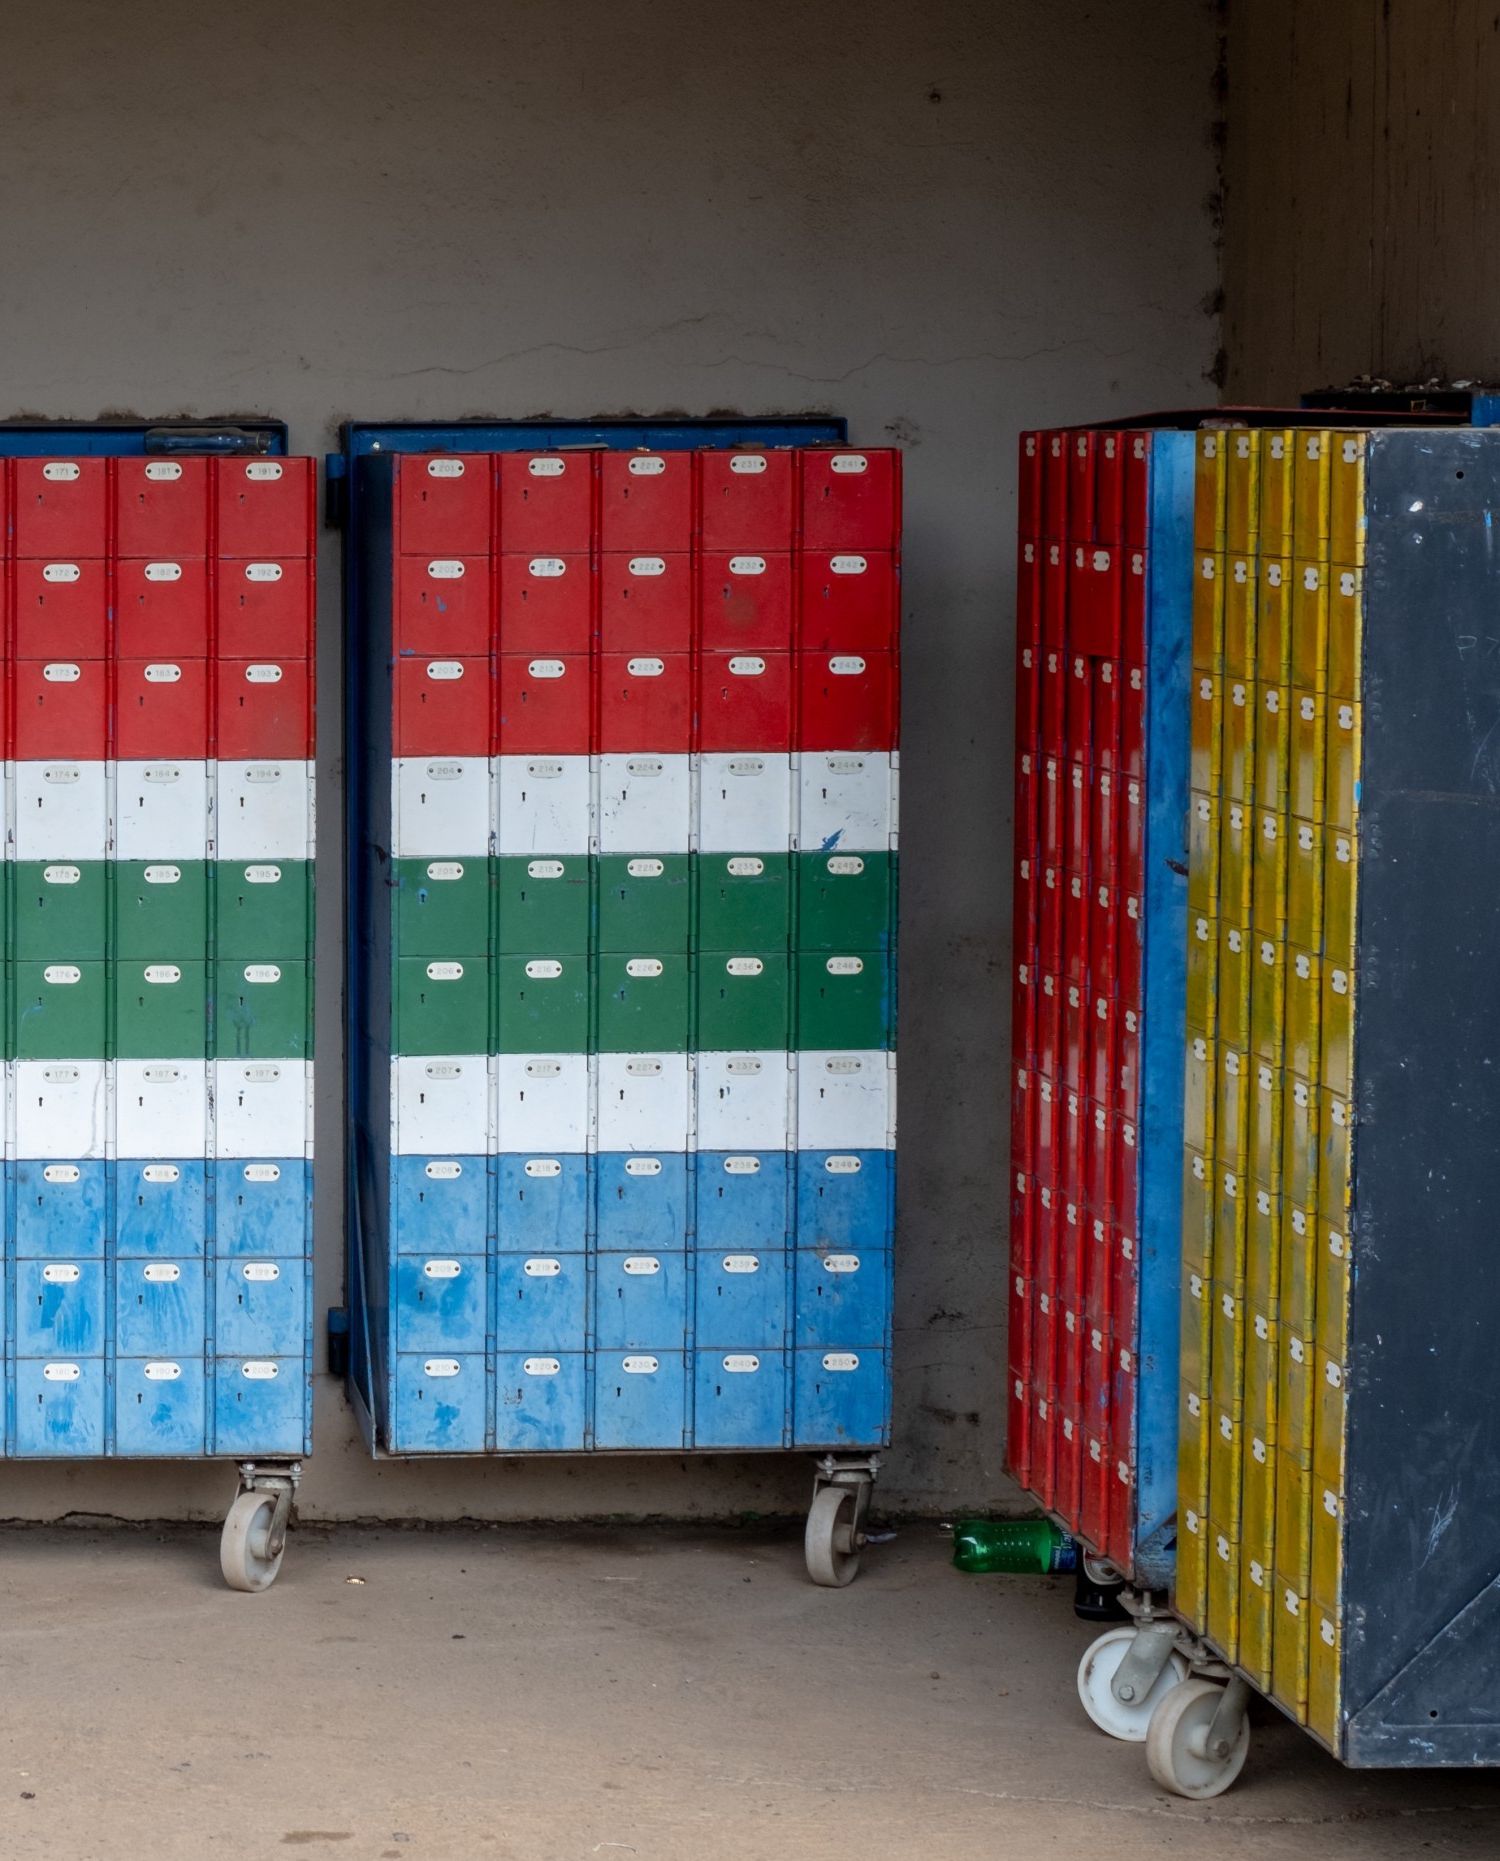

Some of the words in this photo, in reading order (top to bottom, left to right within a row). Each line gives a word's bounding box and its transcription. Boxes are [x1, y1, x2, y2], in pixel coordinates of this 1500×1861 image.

[639, 461, 655, 470] 221
[841, 460, 857, 468] 241
[55, 467, 68, 475] 171
[157, 466, 171, 475] 181
[258, 467, 271, 475] 191
[638, 562, 656, 570] 222
[839, 560, 857, 569] 242
[156, 568, 171, 576] 182
[257, 568, 272, 576] 192
[637, 662, 655, 671] 223
[738, 661, 756, 670] 233
[838, 661, 857, 669] 243
[55, 668, 69, 676] 173
[155, 669, 170, 677] 183
[256, 669, 271, 677] 193
[538, 764, 554, 772] 214
[636, 763, 654, 771] 224
[737, 762, 755, 770] 234
[837, 761, 855, 769] 244
[154, 769, 170, 777] 184
[256, 769, 271, 777] 194
[436, 766, 454, 774] 204
[538, 865, 554, 873] 215
[637, 863, 654, 871] 225
[736, 862, 755, 871] 235
[836, 861, 855, 869] 245
[55, 870, 70, 878] 175
[155, 870, 170, 878] 185
[255, 870, 271, 878] 195
[636, 963, 653, 972] 226
[736, 962, 754, 970] 236
[836, 961, 854, 969] 246
[55, 970, 70, 978] 176
[736, 1061, 753, 1070] 237
[835, 1061, 853, 1069] 247
[154, 1069, 169, 1077] 187
[255, 1069, 270, 1077] 197
[435, 1066, 452, 1074] 207
[733, 1161, 751, 1169] 238
